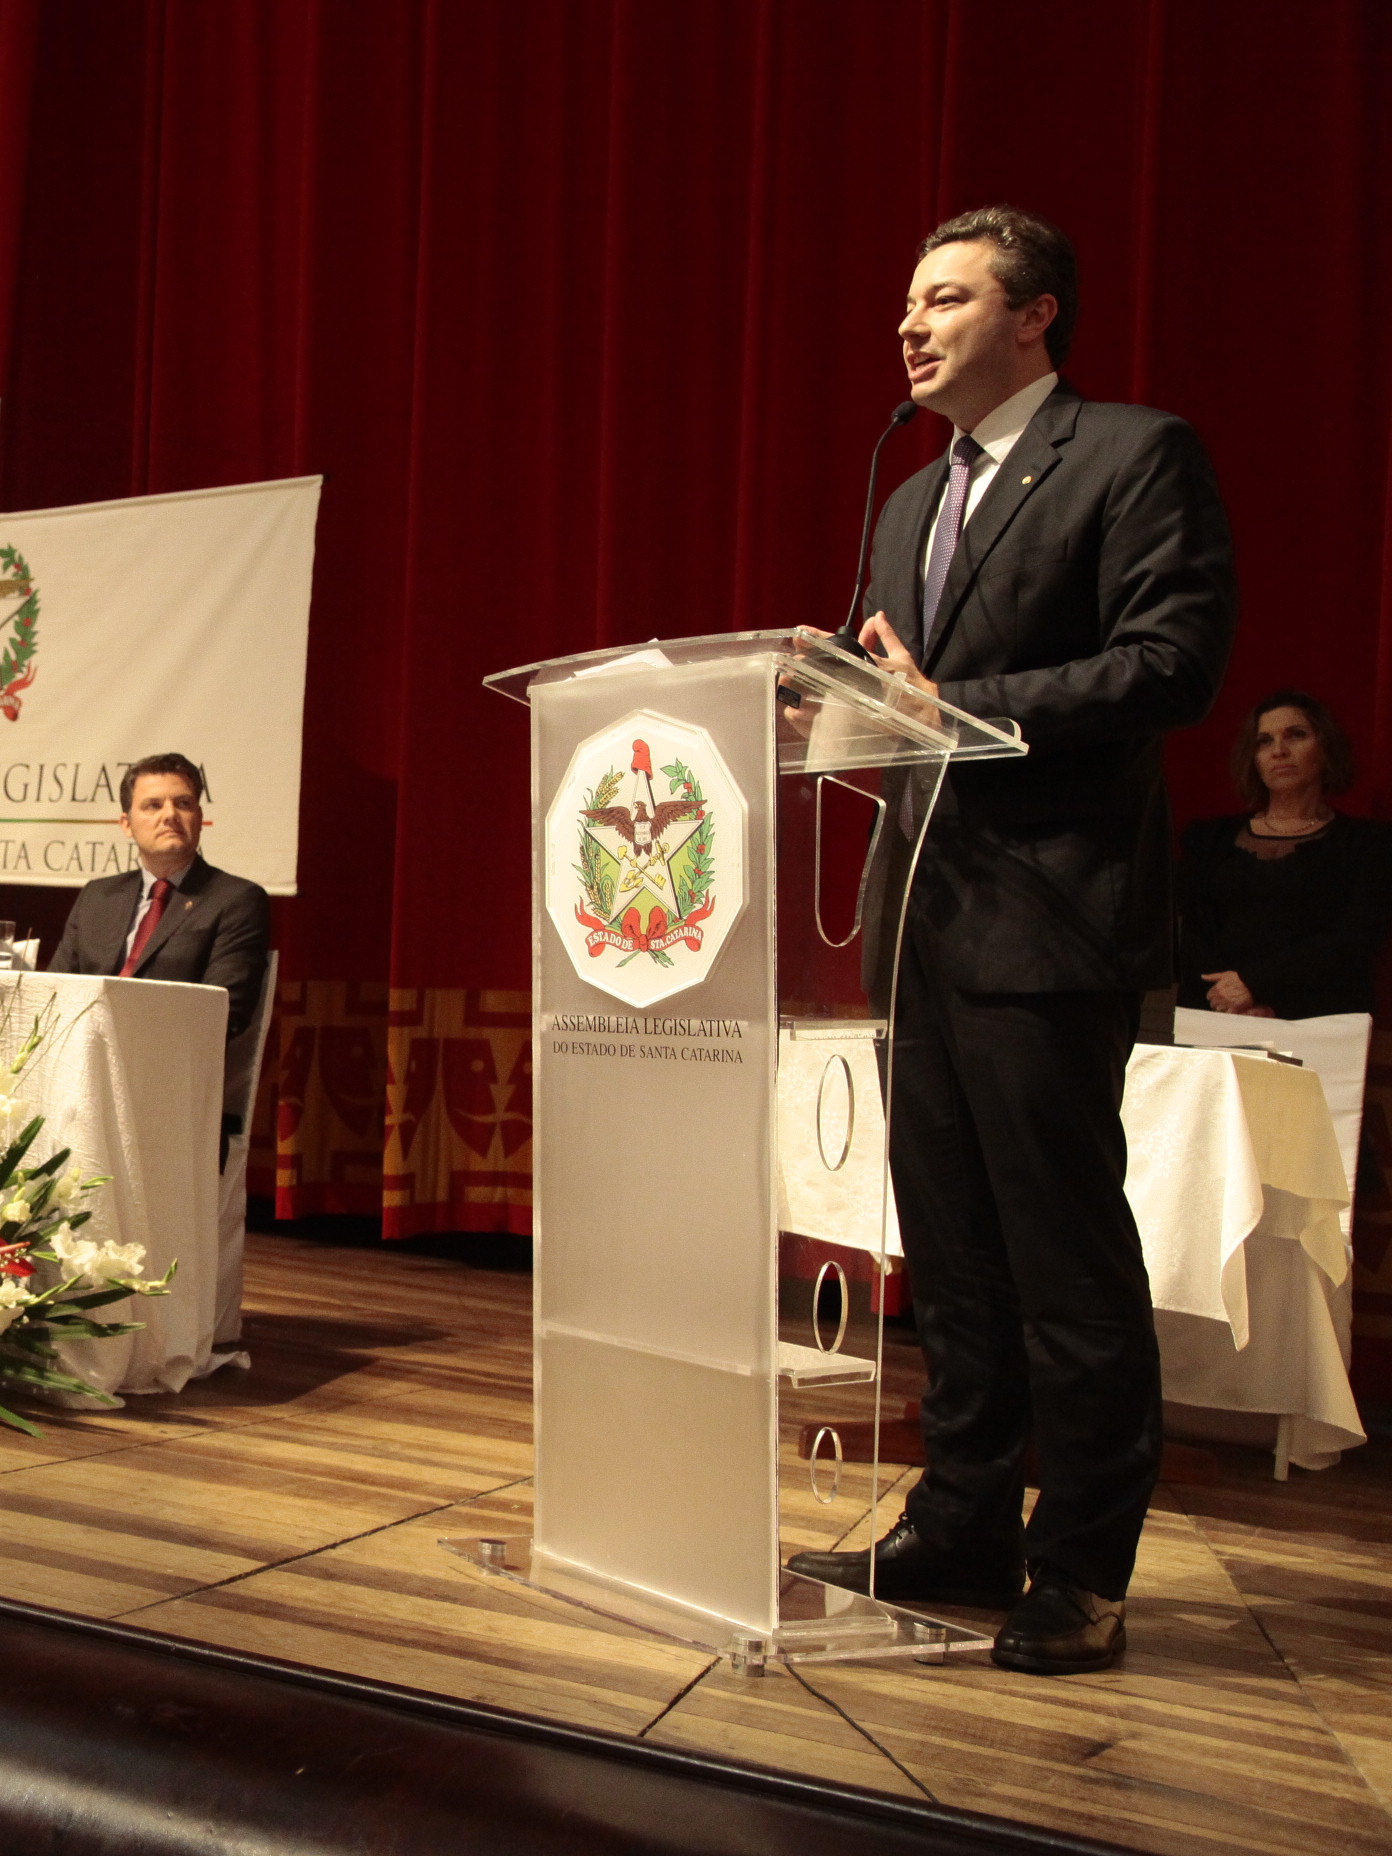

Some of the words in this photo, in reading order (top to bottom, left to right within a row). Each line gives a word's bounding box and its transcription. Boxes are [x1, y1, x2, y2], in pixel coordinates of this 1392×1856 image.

[43, 839, 204, 873] CATAR
[587, 931, 622, 947] ESTADO
[622, 939, 634, 950] DE
[551, 1014, 640, 1034] ASSEMBLEIA
[644, 1017, 743, 1038] LEGISLATIVA
[553, 1041, 568, 1054] DO
[571, 1041, 616, 1057] ESTADO
[620, 1044, 636, 1058] DE
[639, 1044, 677, 1060] SANTA
[681, 1047, 743, 1064] CATARINA
